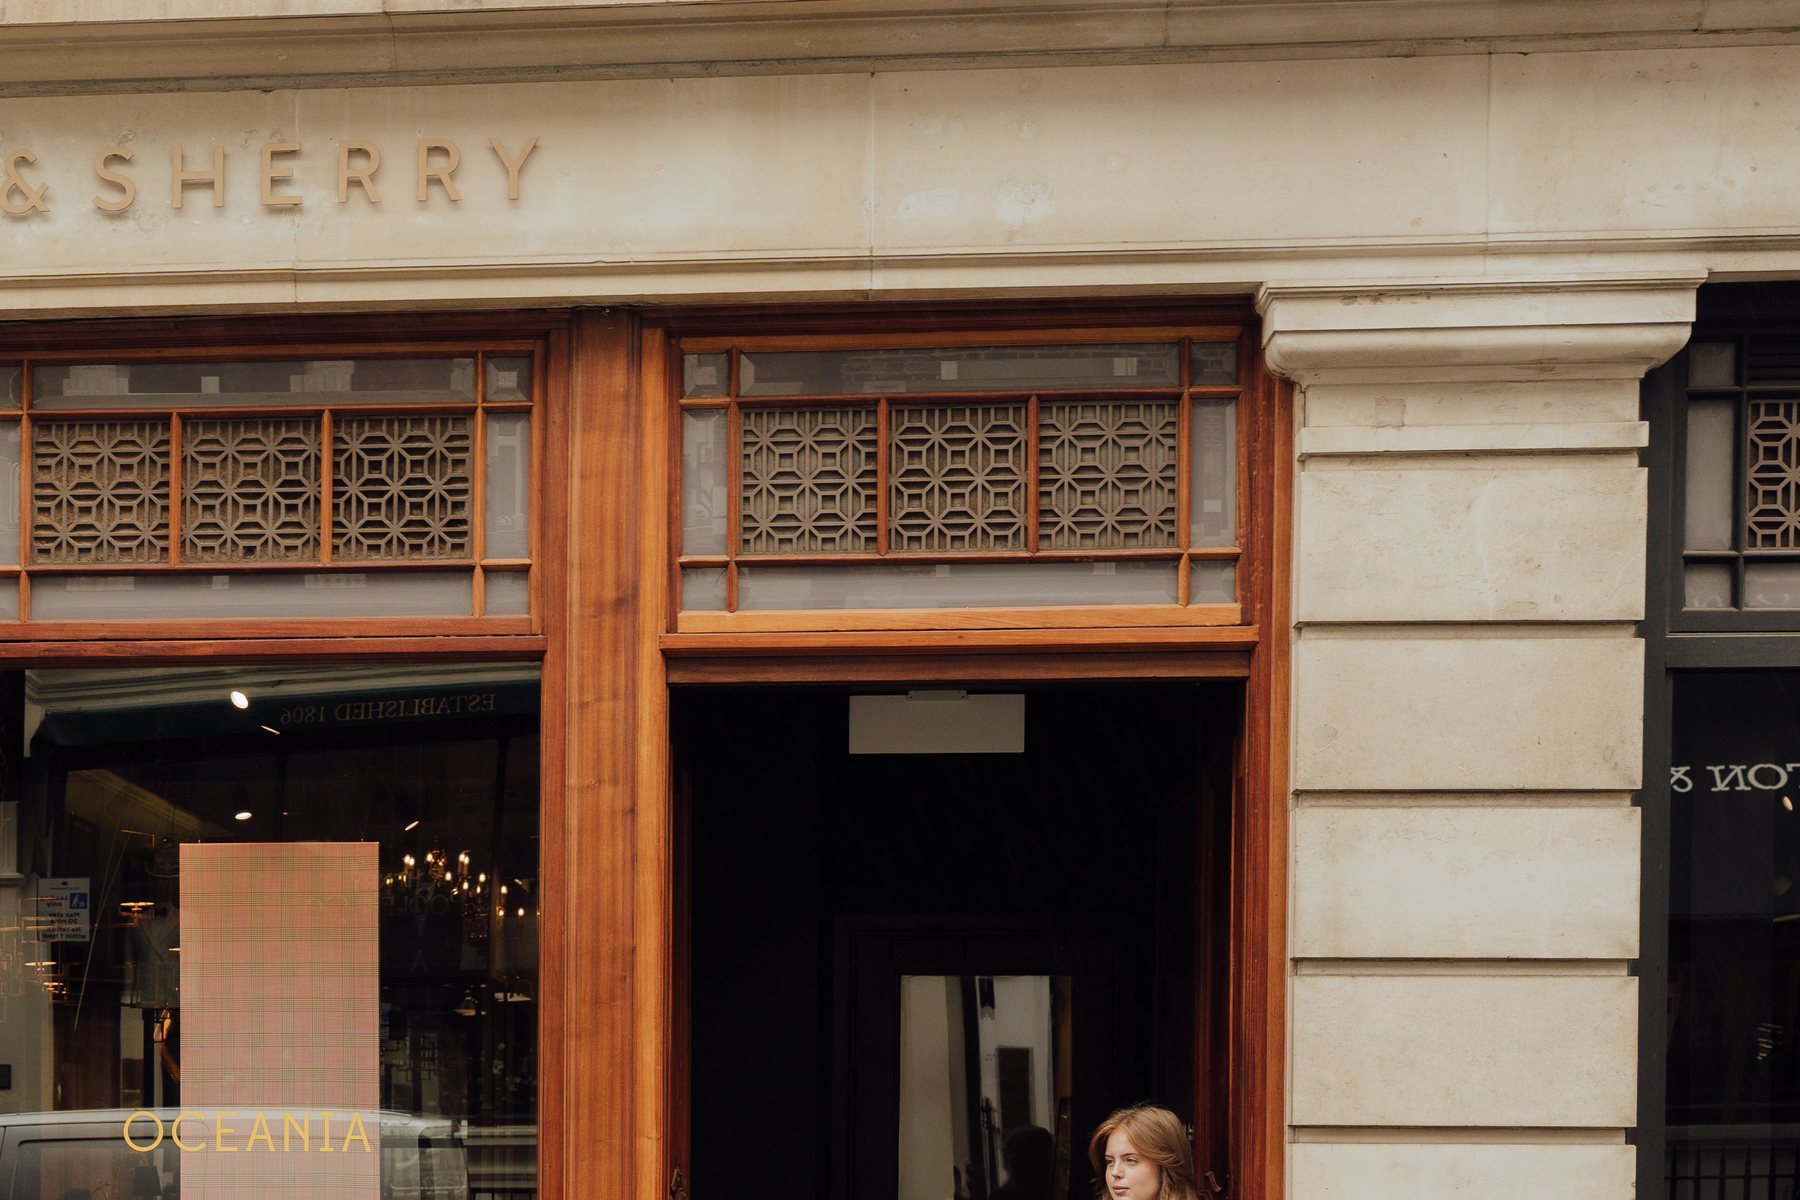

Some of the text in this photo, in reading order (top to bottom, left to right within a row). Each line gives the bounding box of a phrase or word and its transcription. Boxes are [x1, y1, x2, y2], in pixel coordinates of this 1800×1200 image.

[0, 136, 541, 214] & SHERRY
[123, 1110, 372, 1152] OCEANIA
